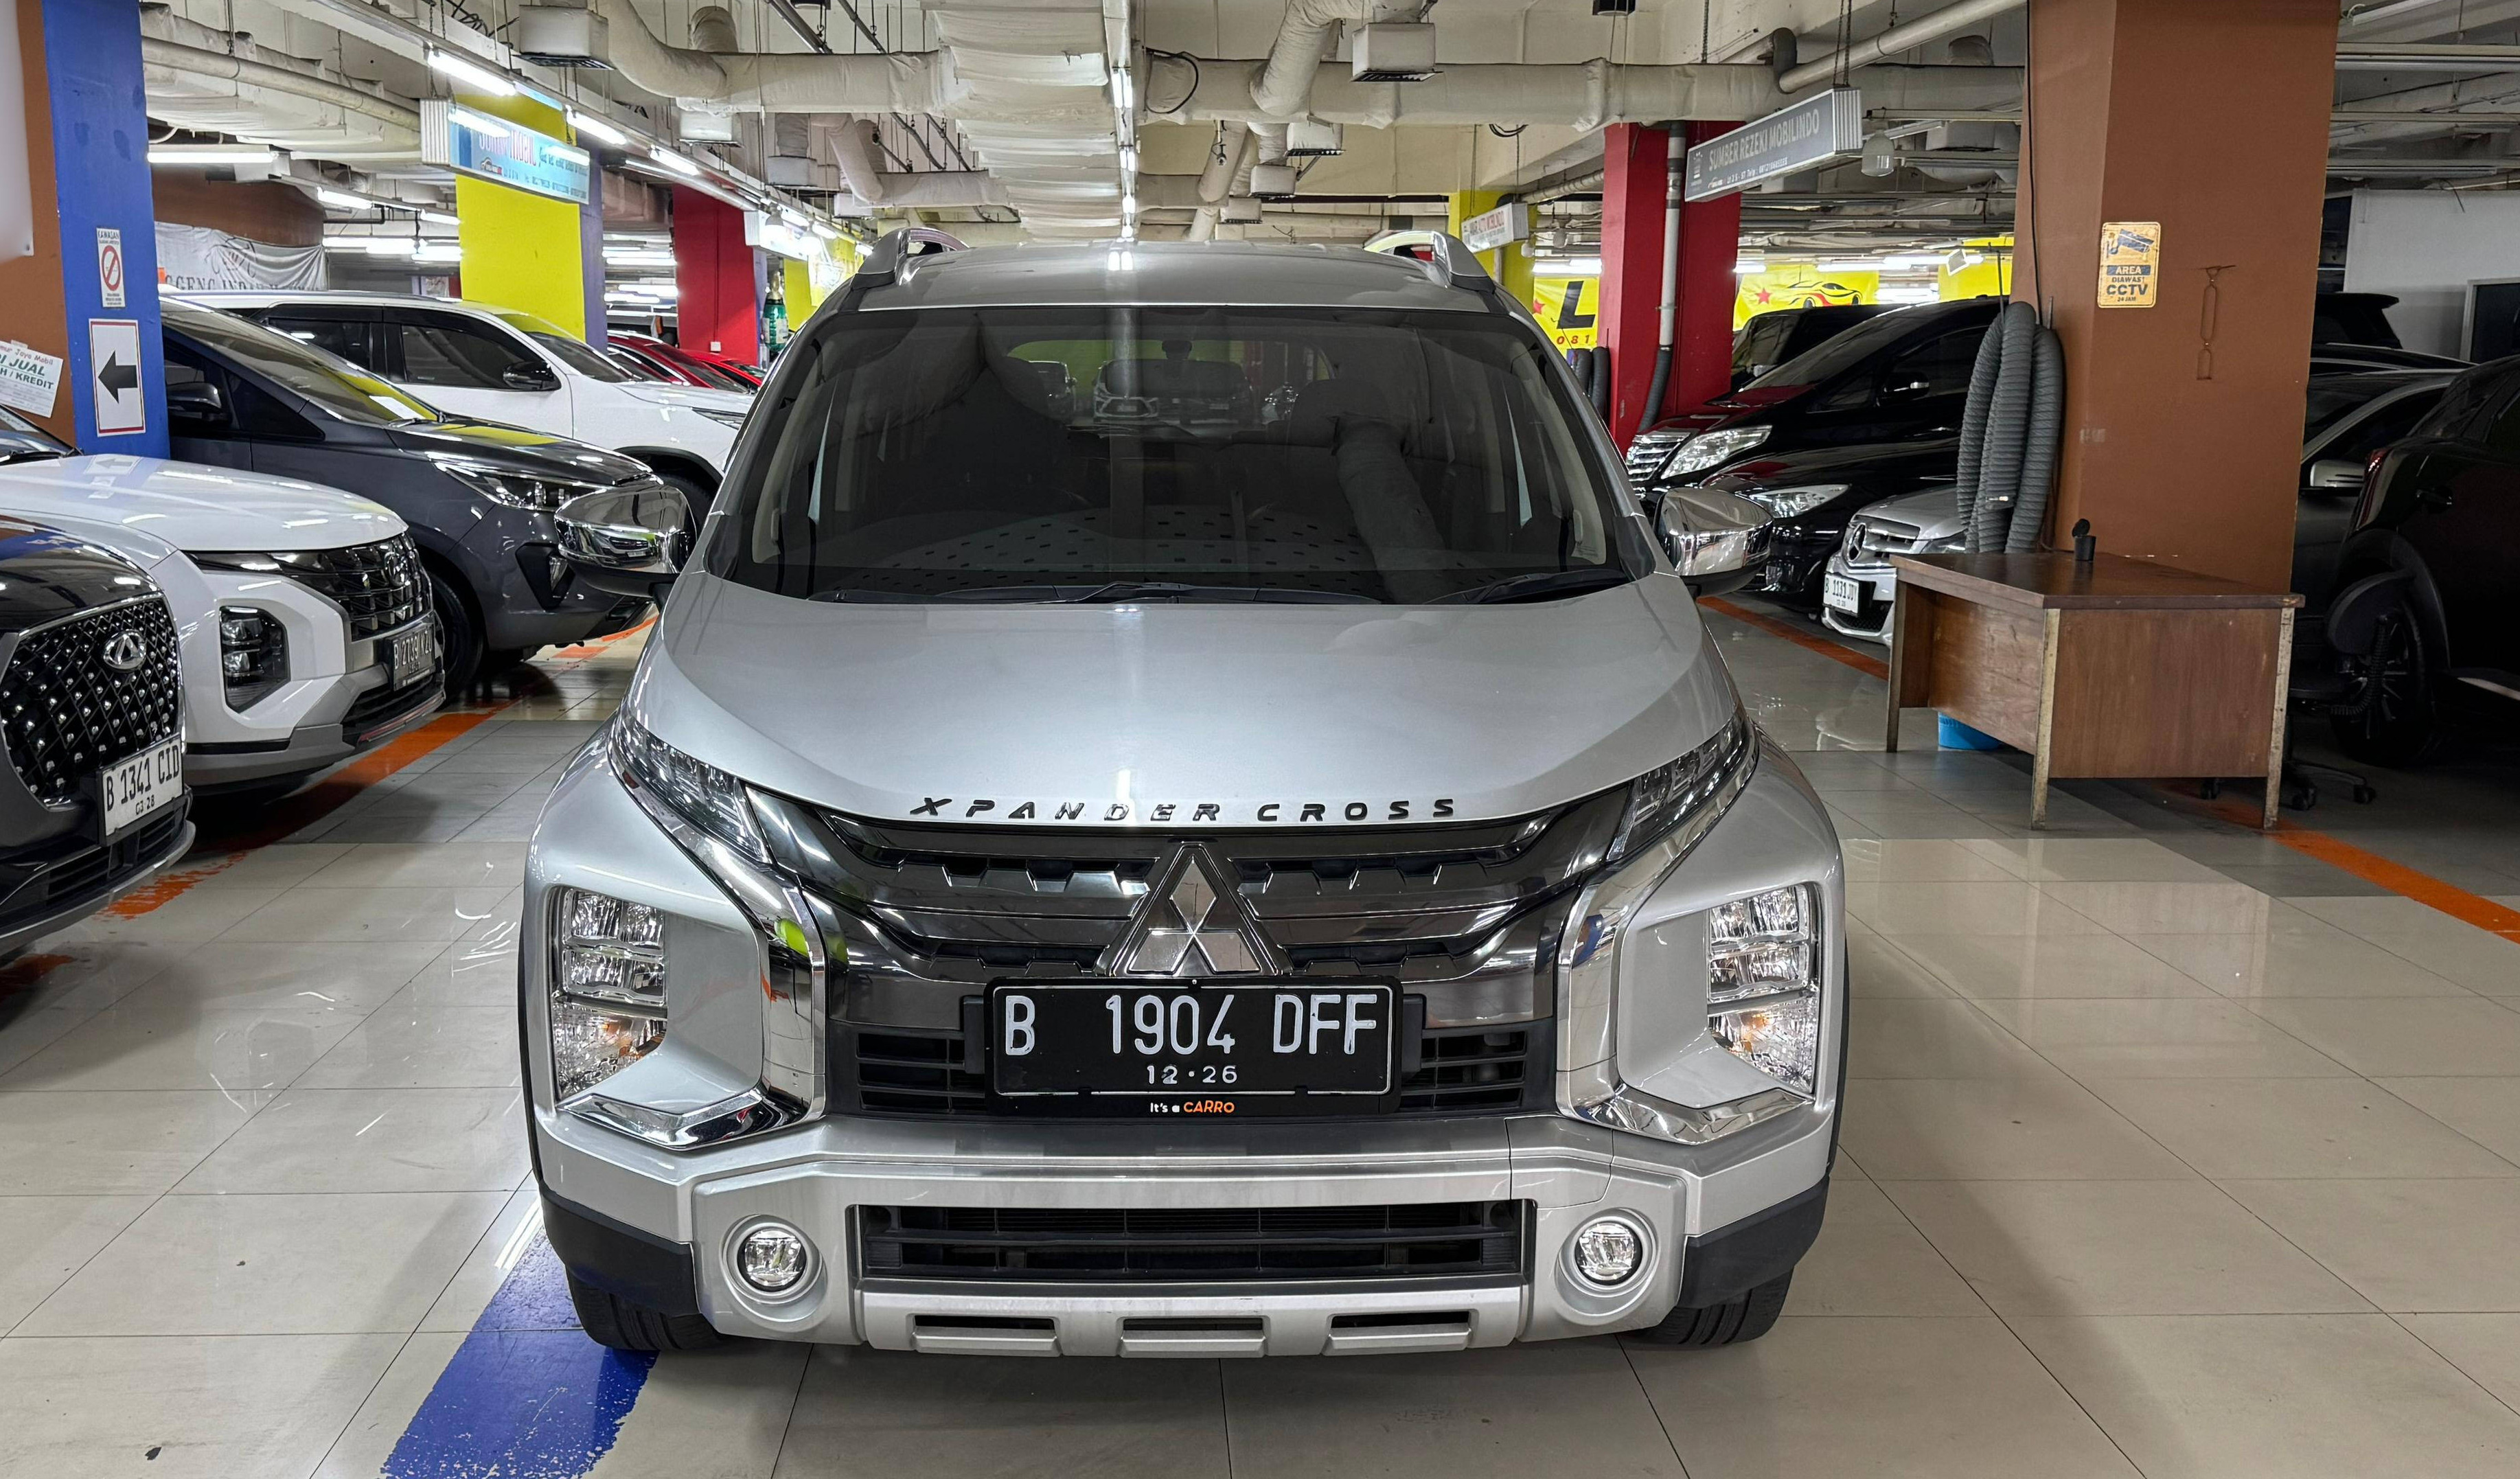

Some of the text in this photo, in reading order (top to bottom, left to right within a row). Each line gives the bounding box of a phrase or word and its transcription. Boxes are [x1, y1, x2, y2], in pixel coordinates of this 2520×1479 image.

[1708, 141, 1739, 172] SUMBER
[1740, 132, 1767, 161] REZEKI
[1769, 108, 1819, 150] MOBILINDO
[2116, 265, 2142, 275] AREA
[2107, 284, 2148, 295] CCTV
[9, 358, 45, 376] JUAL
[34, 355, 53, 365] Mobil
[16, 372, 54, 389] KREDIT
[393, 643, 399, 669] B
[402, 635, 419, 665] 2739
[106, 744, 180, 812] B 1341 CID
[146, 794, 155, 810] 28
[909, 797, 1454, 822] XPANDER CROSS
[1005, 994, 1378, 1055] B 1904 DFF
[1150, 1102, 1169, 1112] It's
[1183, 1099, 1235, 1113] CARRO
